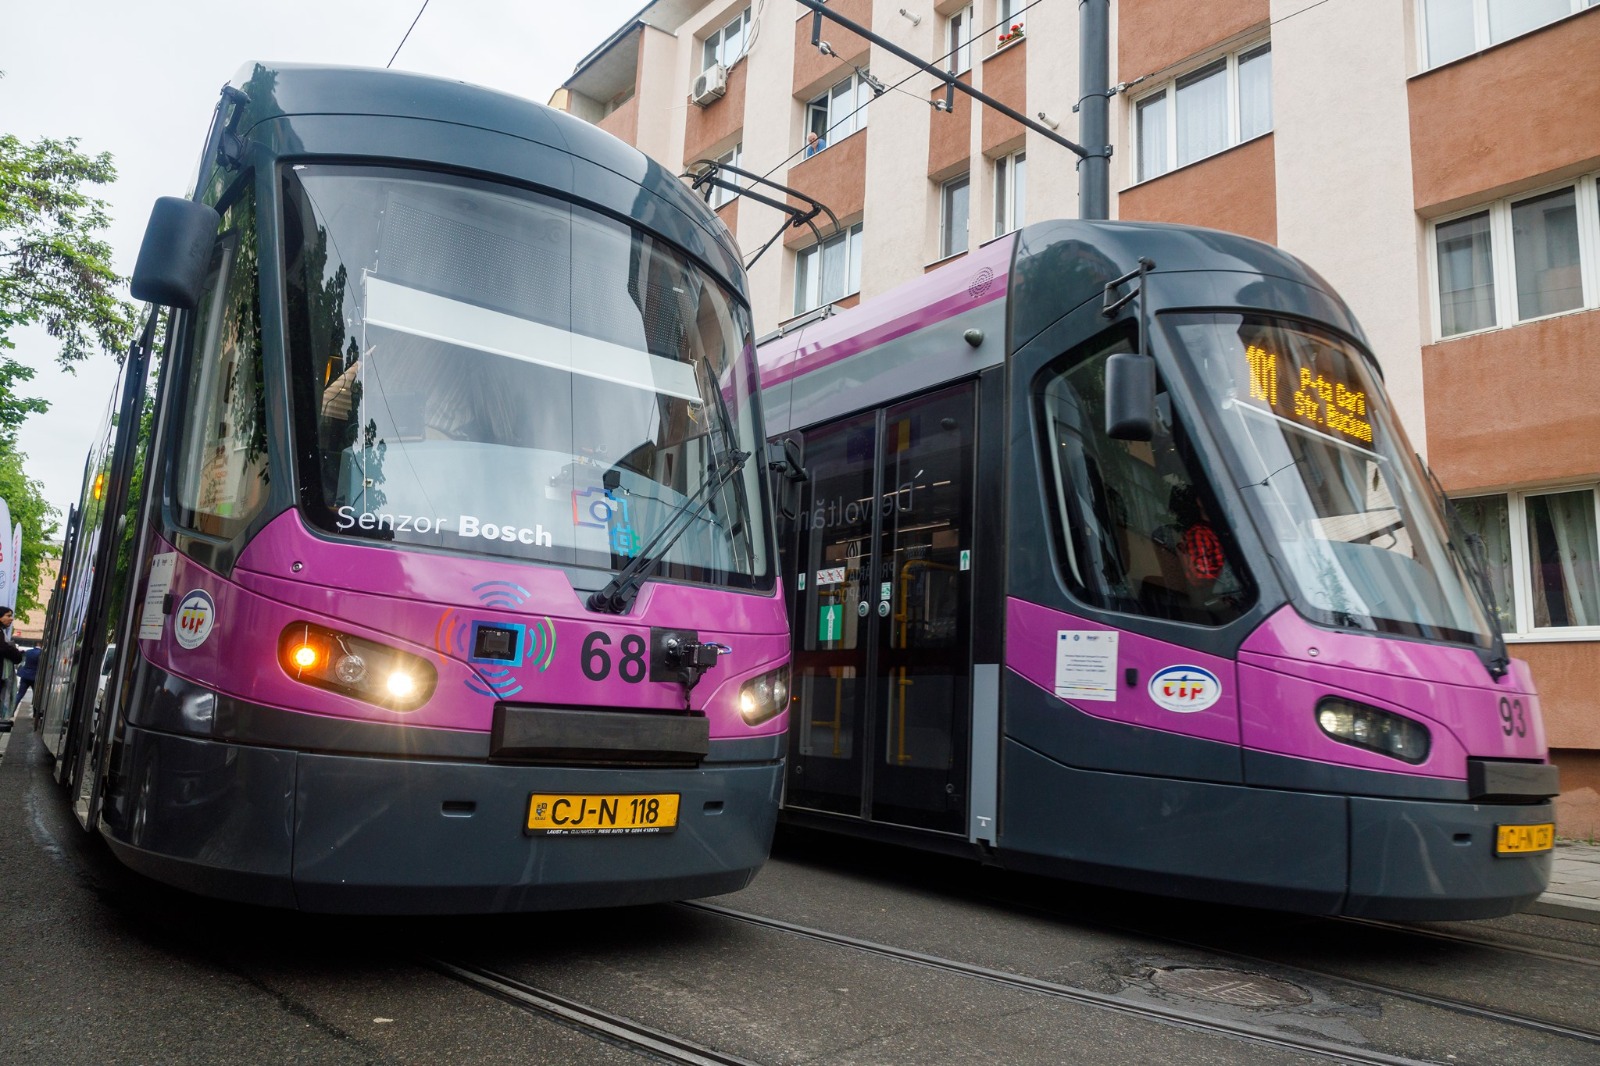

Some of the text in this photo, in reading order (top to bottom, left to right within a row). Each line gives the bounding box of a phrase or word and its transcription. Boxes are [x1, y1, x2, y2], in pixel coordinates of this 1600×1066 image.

[335, 505, 552, 548] Senzor Bosch
[581, 631, 646, 683] 68
[1500, 697, 1526, 738] 93
[551, 798, 659, 825] CJ-N 118
